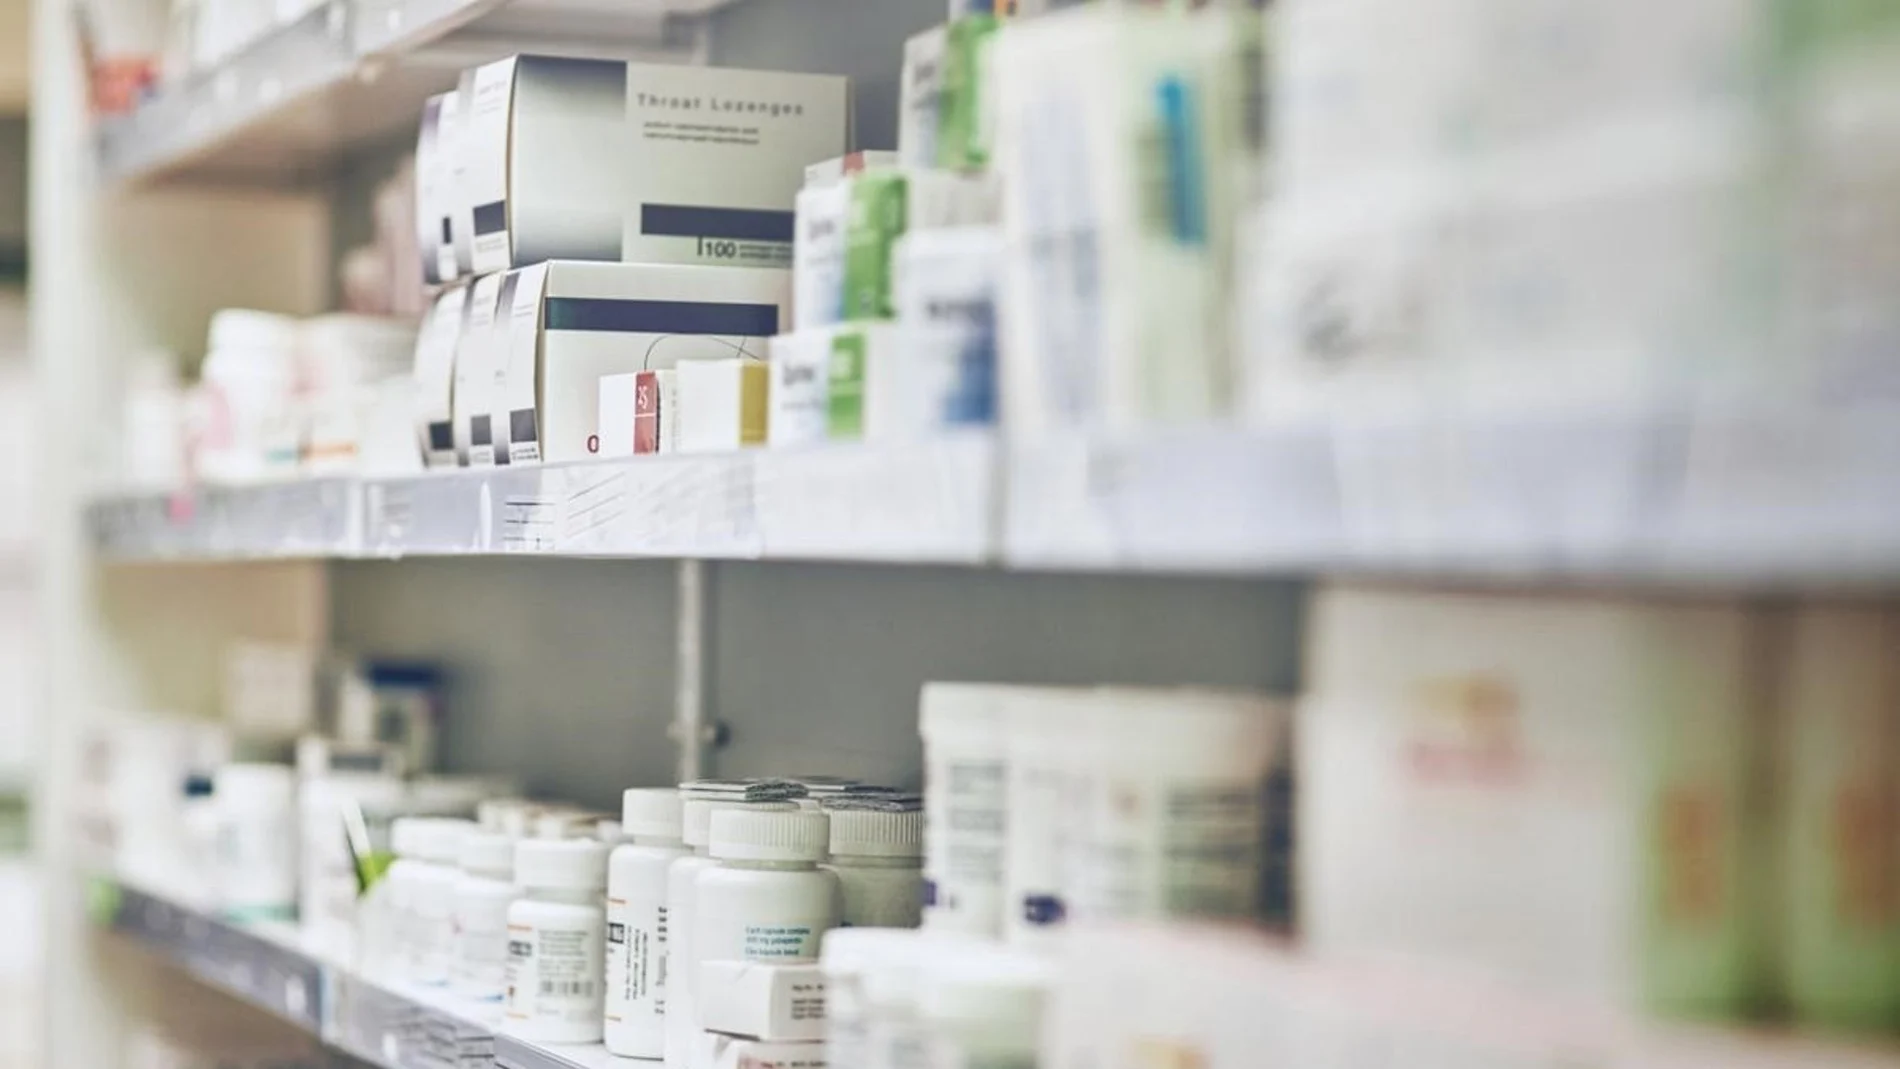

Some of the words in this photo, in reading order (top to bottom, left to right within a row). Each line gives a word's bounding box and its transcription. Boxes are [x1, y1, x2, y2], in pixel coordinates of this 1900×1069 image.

[637, 92, 700, 110] Throat
[710, 98, 803, 117] Lozenges
[705, 241, 737, 258] 100
